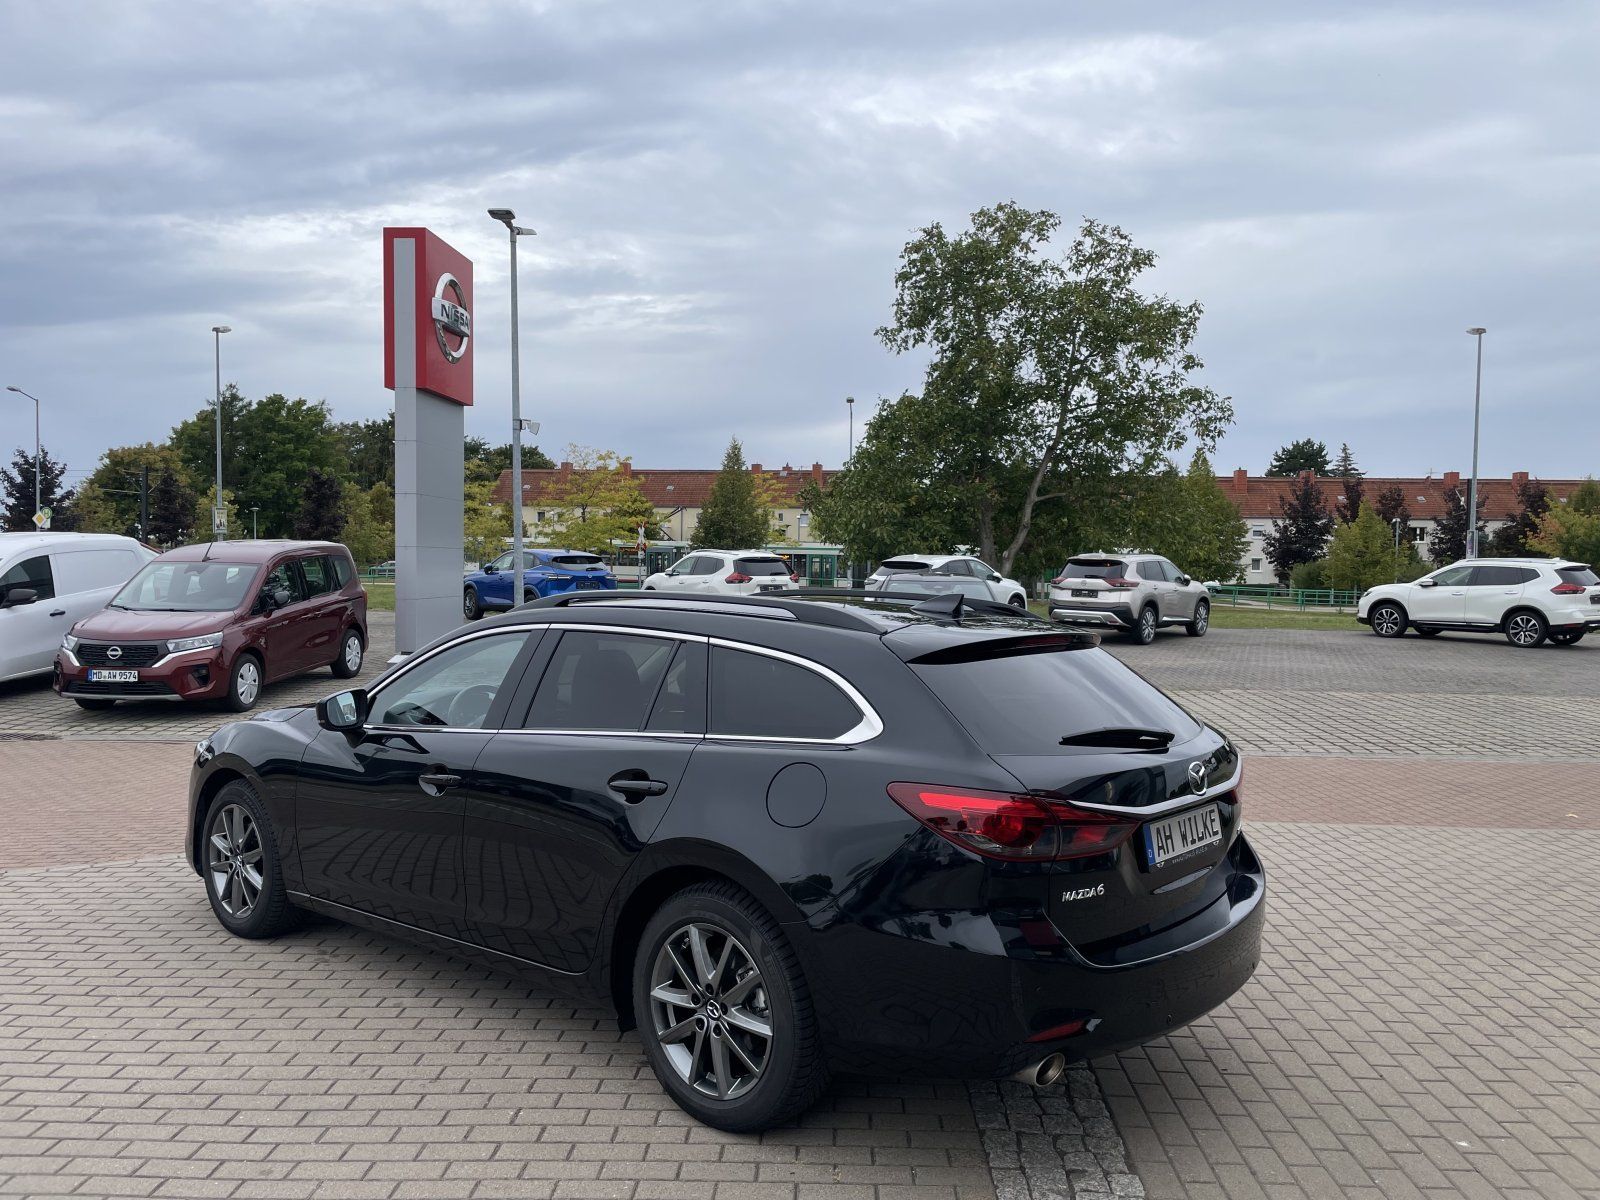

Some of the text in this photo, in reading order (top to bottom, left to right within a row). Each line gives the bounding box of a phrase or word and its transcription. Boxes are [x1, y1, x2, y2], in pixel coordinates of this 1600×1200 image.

[440, 303, 470, 330] NISSA
[92, 671, 137, 680] MD AW 9574
[1155, 823, 1175, 858] AH
[1177, 808, 1219, 848] WILKE
